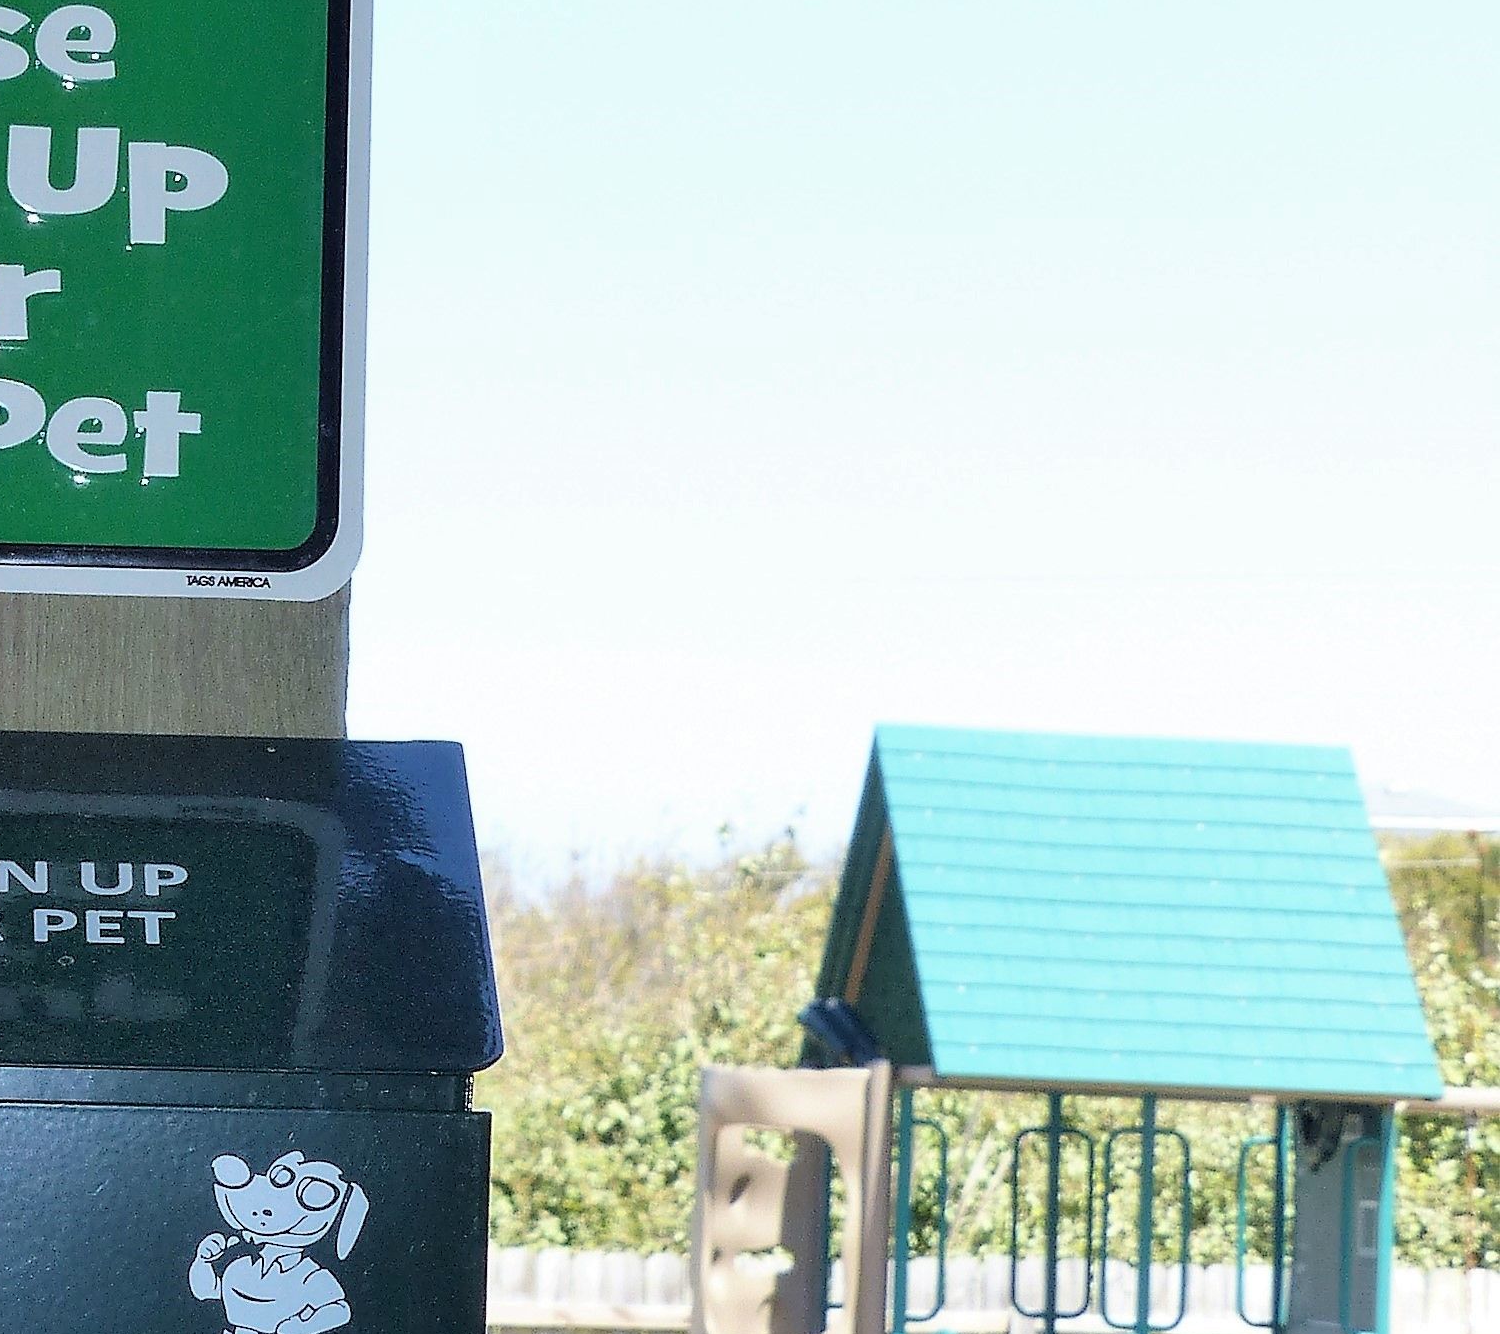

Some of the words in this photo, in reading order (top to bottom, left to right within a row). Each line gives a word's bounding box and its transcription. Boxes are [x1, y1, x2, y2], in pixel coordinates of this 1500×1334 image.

[8, 125, 228, 244] Up
[186, 576, 215, 586] TAGS
[217, 576, 271, 588] AMERICA
[81, 862, 188, 896] UP
[33, 909, 176, 944] PET
